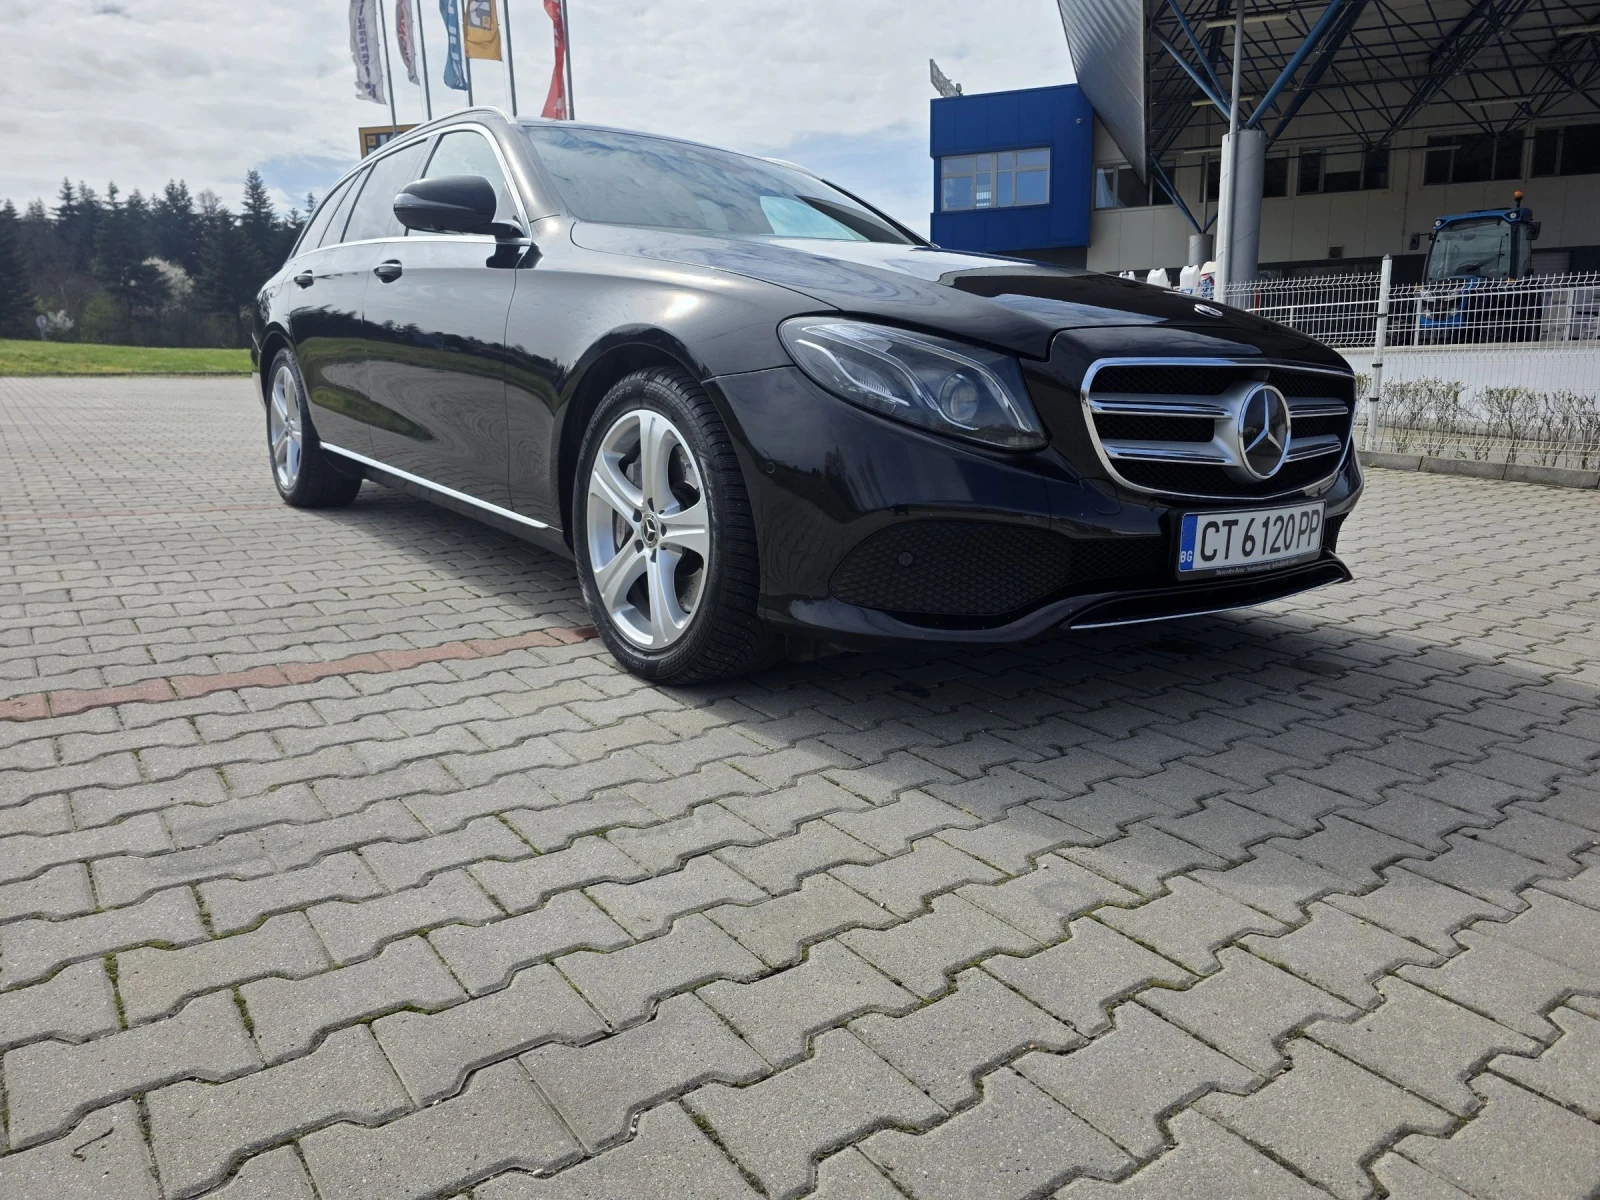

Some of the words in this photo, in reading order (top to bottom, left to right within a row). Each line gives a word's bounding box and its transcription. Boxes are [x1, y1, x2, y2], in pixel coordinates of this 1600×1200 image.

[1200, 519, 1239, 562] CT
[1241, 513, 1296, 557] 6120
[1296, 509, 1320, 549] PP
[1180, 550, 1193, 563] BG
